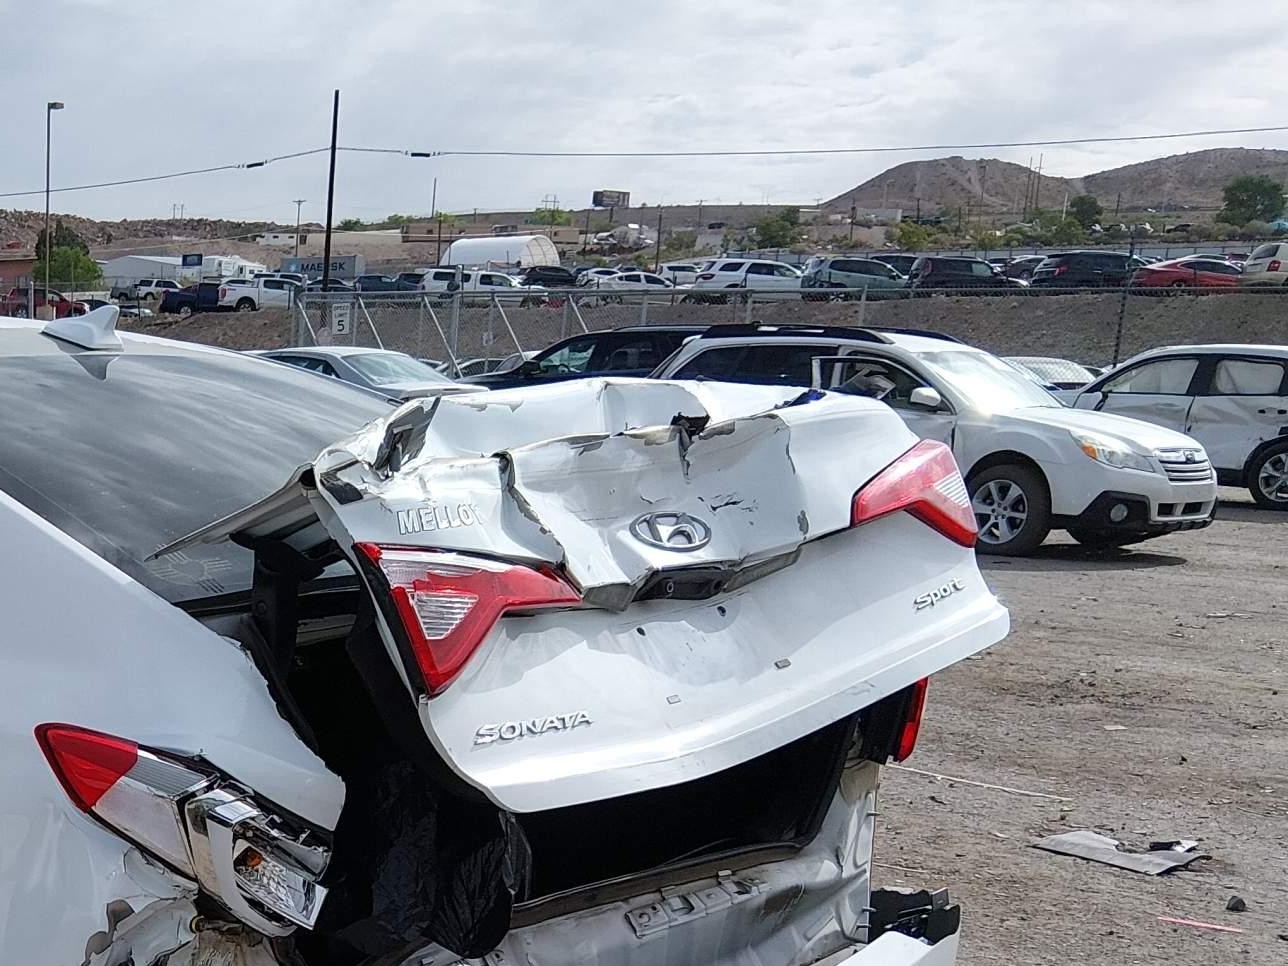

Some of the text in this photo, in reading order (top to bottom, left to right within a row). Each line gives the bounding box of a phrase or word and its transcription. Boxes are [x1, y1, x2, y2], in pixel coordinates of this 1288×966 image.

[301, 261, 345, 272] MAESK
[337, 319, 345, 332] 5
[913, 577, 966, 611] Sport
[472, 710, 593, 746] SONATA
